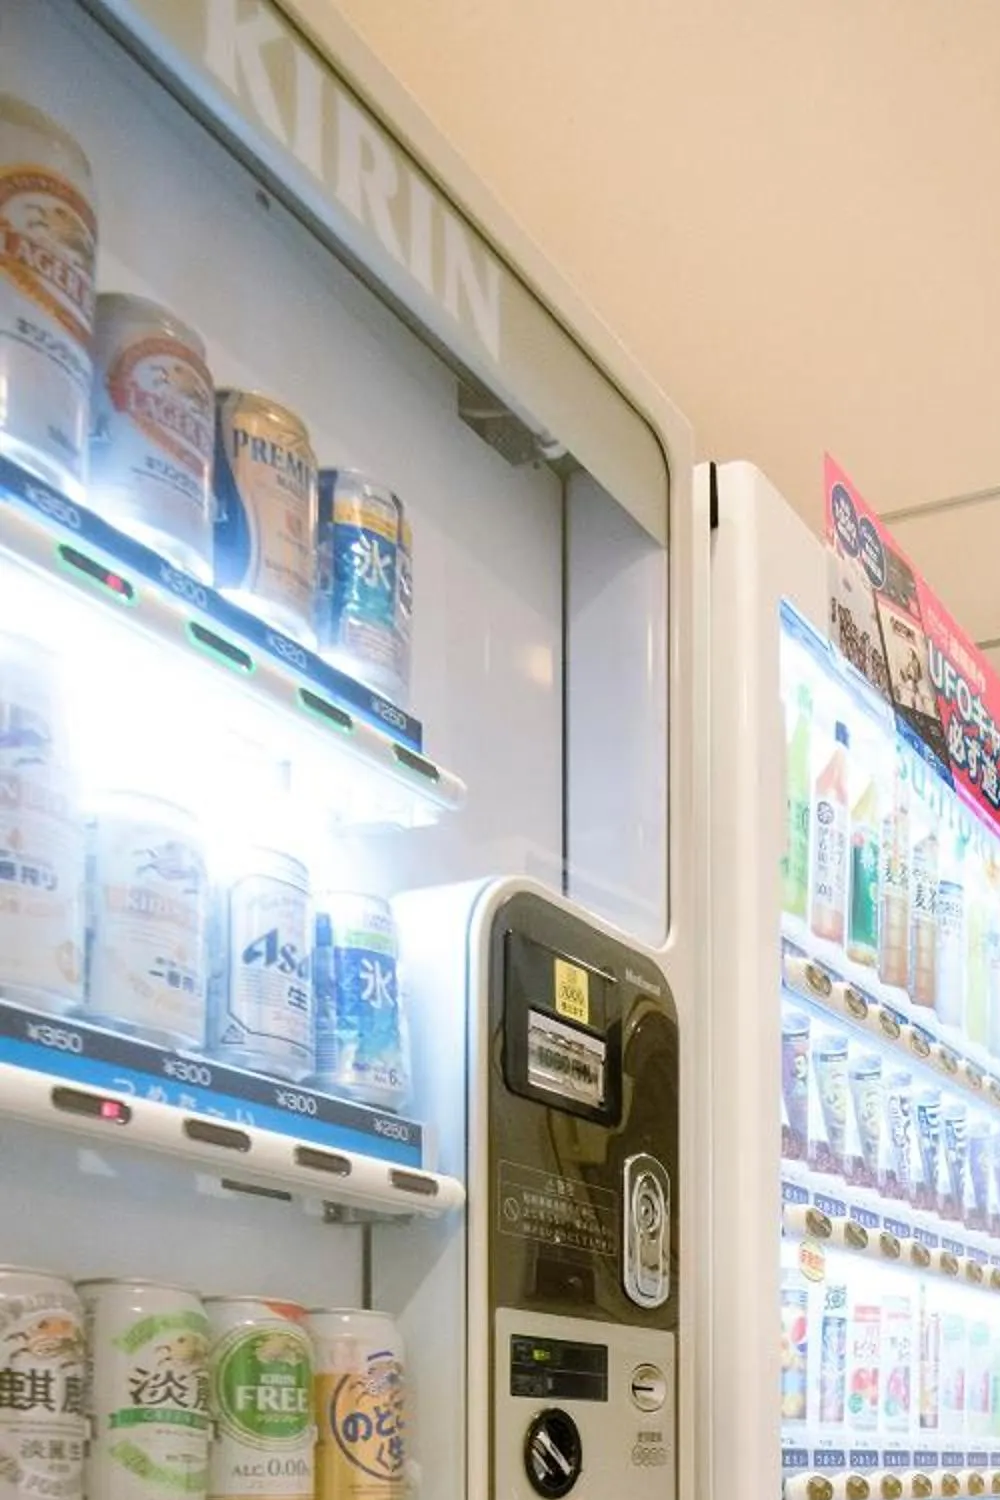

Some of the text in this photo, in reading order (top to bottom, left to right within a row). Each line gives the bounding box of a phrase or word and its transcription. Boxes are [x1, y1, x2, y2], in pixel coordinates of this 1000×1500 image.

[204, 0, 500, 362] KIRIN
[358, 956, 397, 1010] 氷
[27, 1022, 83, 1053] ¥350
[163, 1058, 212, 1087] ¥300
[276, 1088, 318, 1116] ¥300
